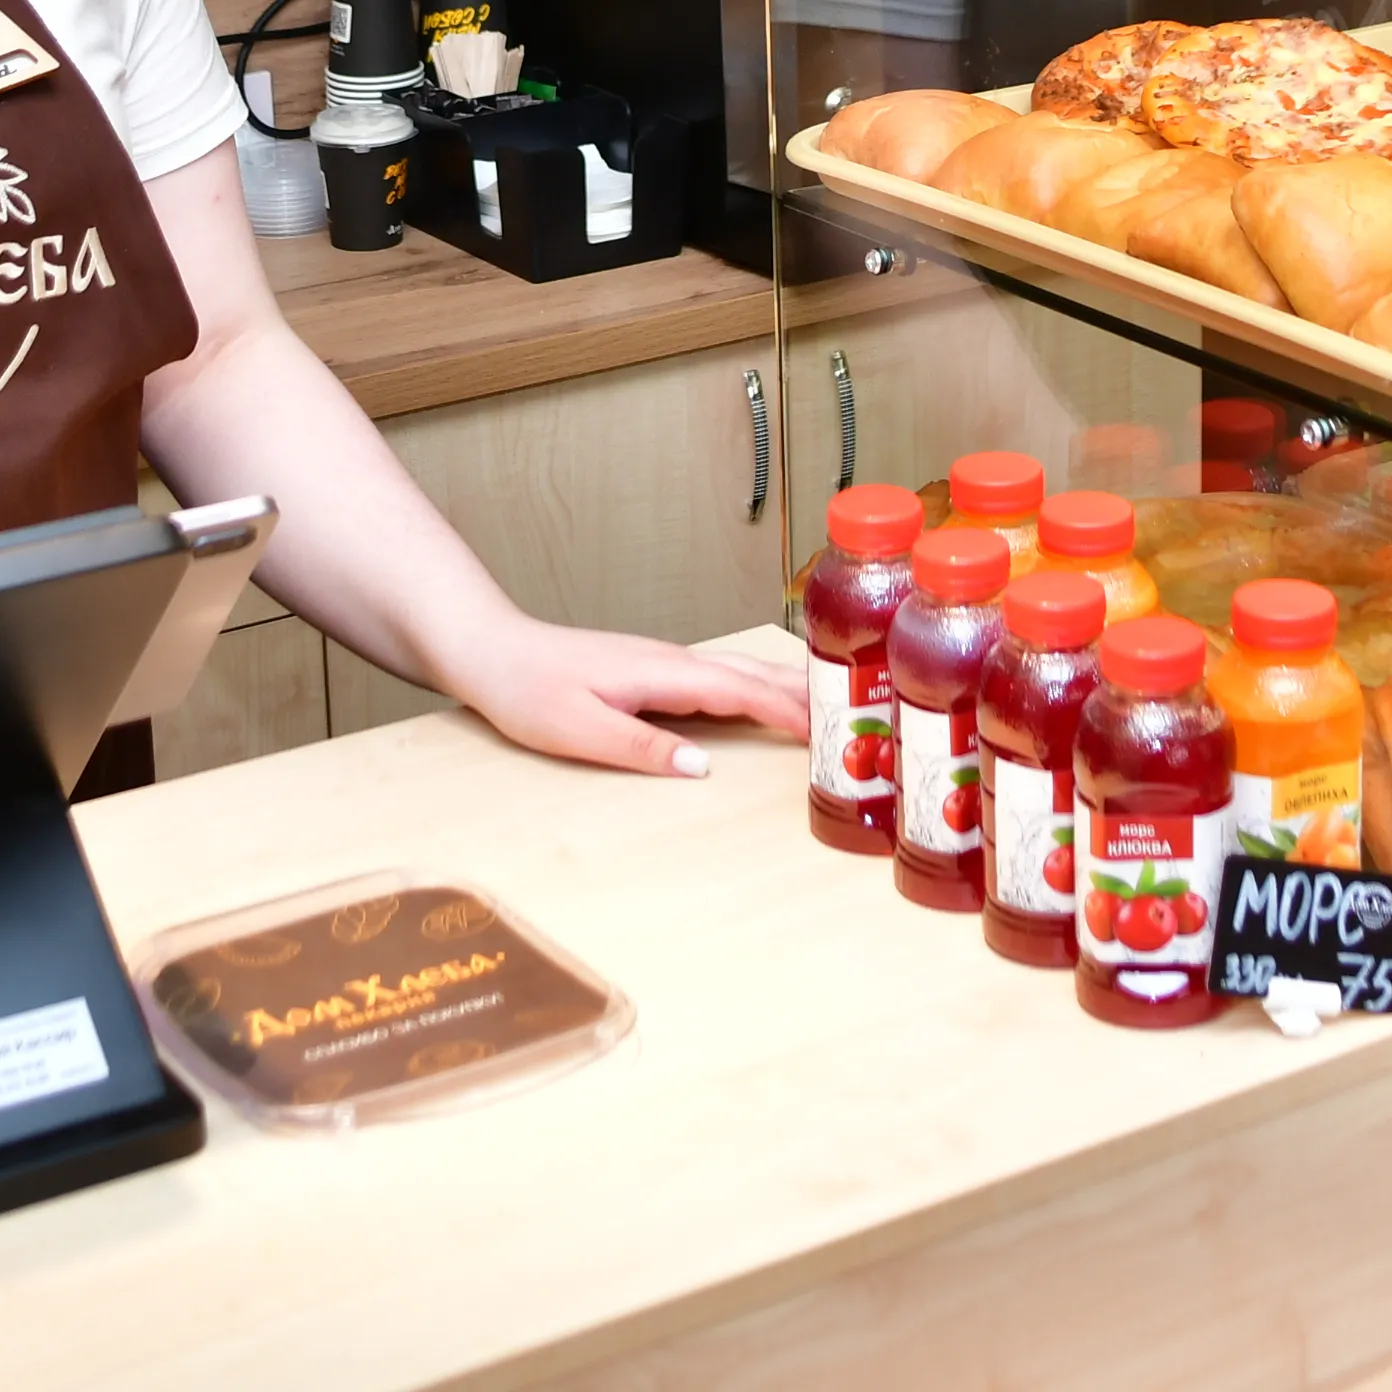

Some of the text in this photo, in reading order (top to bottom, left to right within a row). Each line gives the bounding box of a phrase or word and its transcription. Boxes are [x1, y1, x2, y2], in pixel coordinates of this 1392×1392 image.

[1284, 787, 1348, 812] ОБЛЕПИХА
[1108, 840, 1172, 857] КЛЮКВА
[1233, 869, 1365, 946] МОРС
